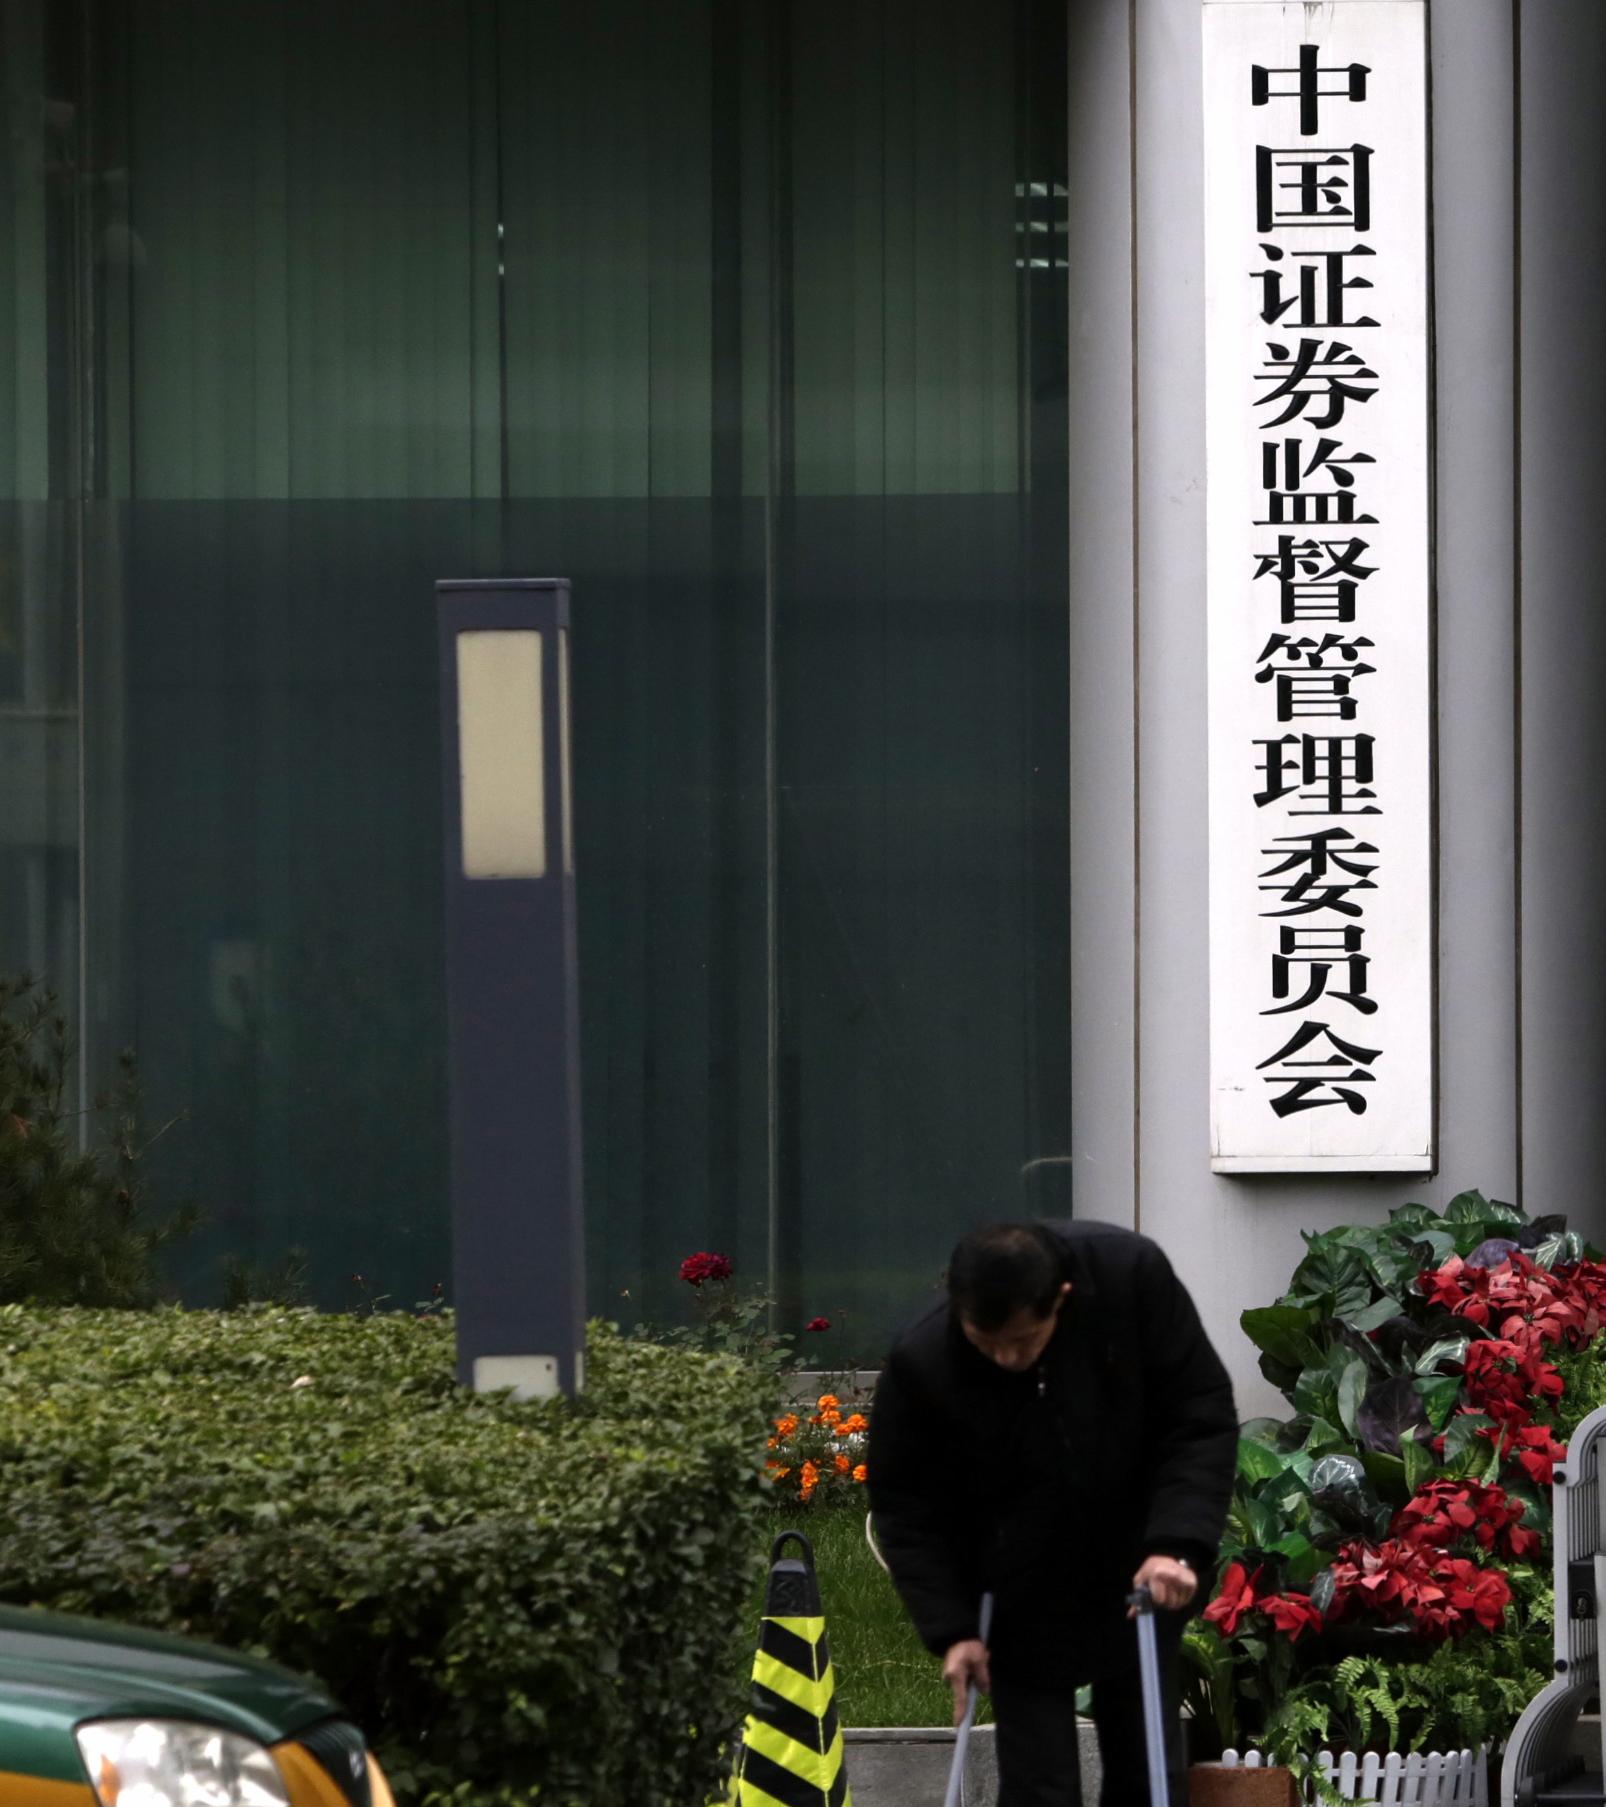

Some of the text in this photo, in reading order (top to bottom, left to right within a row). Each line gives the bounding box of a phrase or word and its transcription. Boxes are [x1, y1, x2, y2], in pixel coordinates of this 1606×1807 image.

[1249, 44, 1383, 1118] 中国证券监督管理委员会
